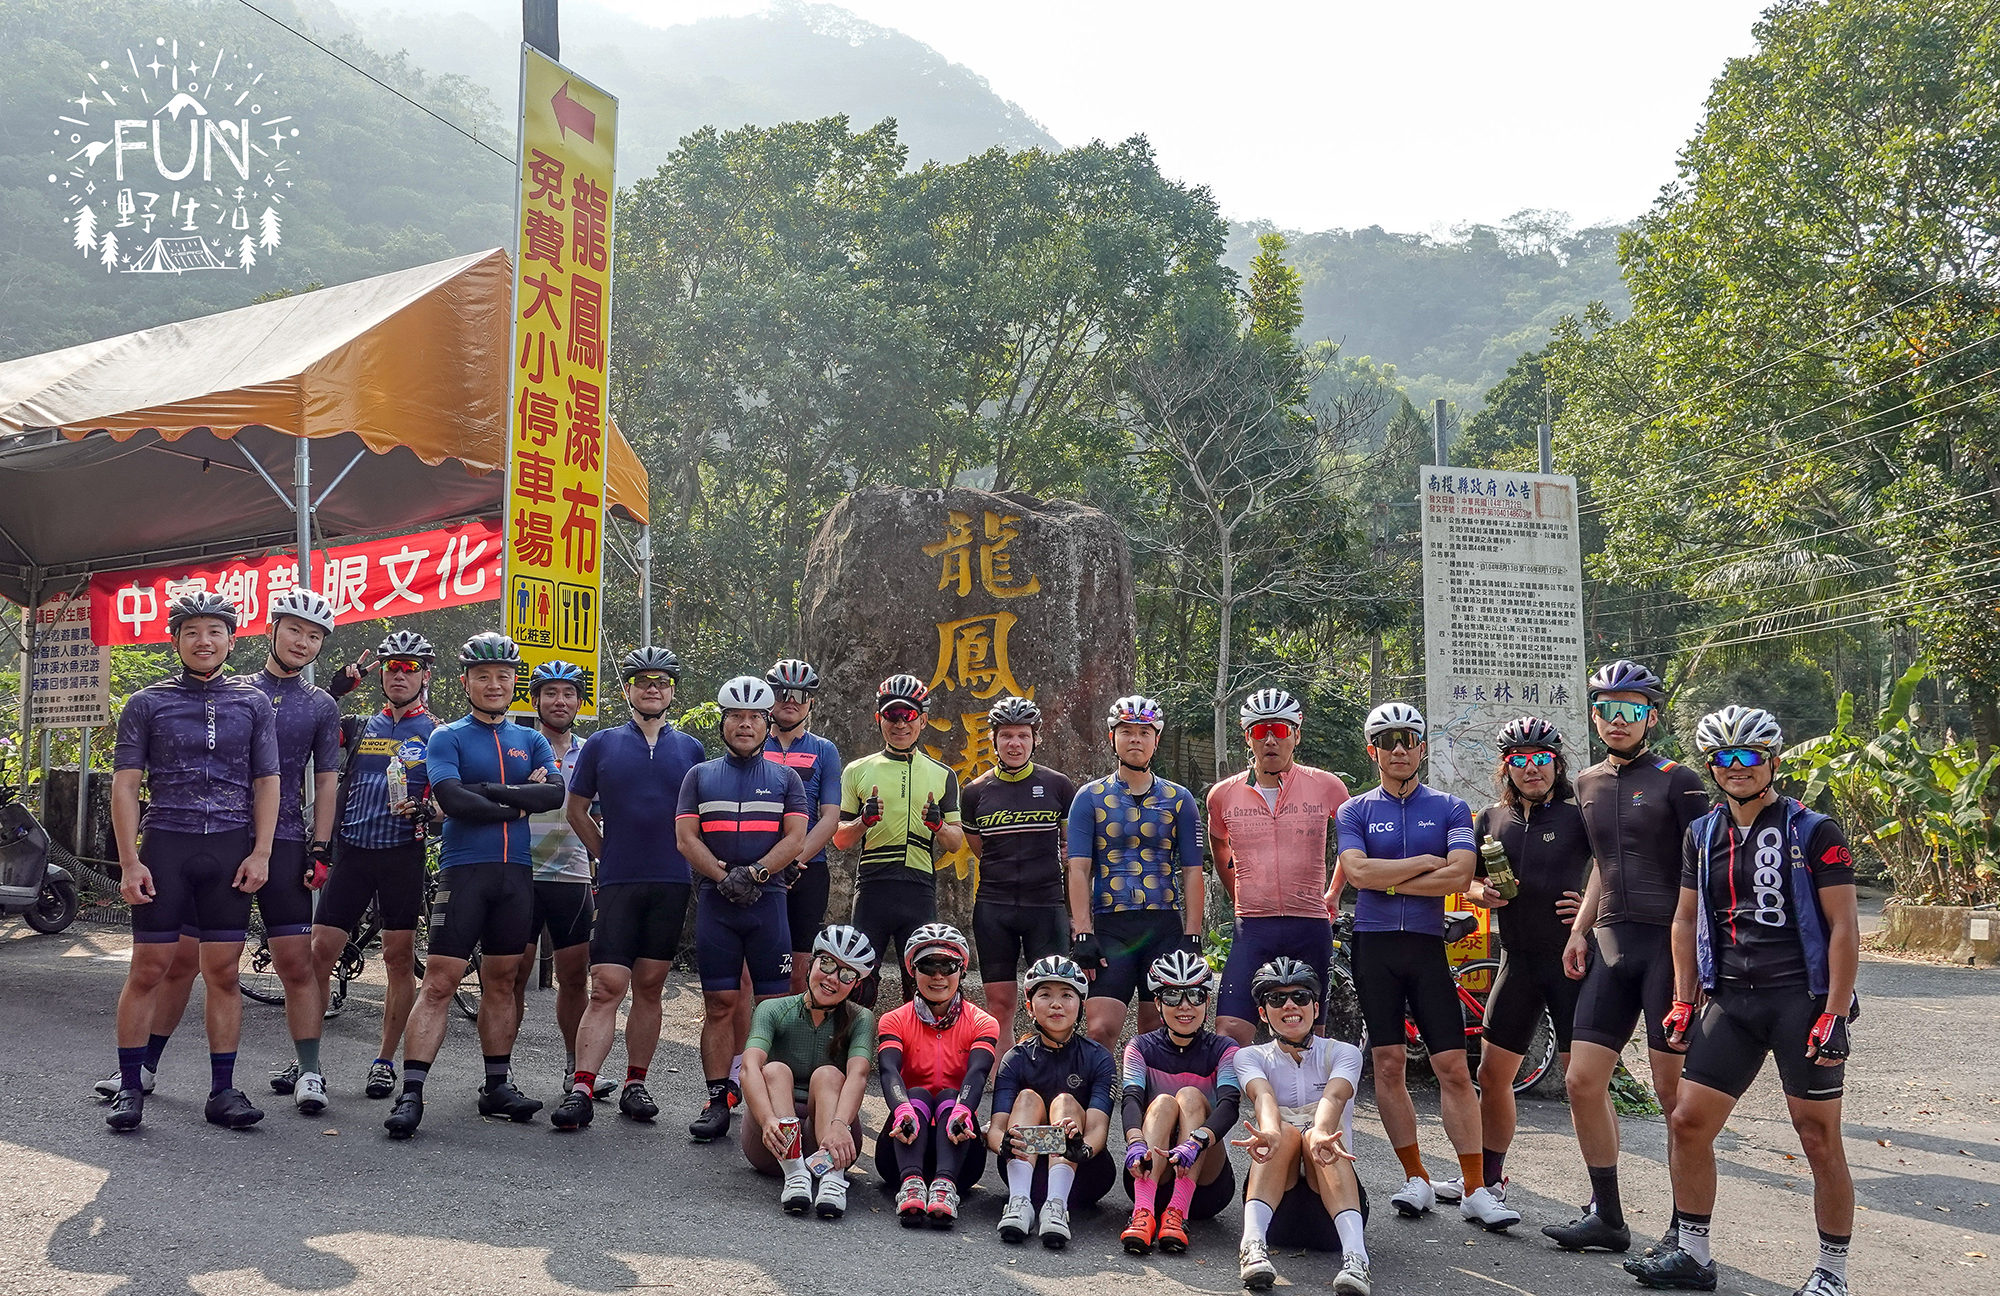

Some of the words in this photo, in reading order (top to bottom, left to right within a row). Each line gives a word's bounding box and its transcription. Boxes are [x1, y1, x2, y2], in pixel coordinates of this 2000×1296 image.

[514, 146, 566, 569] 免費大小停車場
[560, 171, 609, 575] 龍鳳瀑布
[1428, 474, 1497, 497] 南投縣政府
[1505, 480, 1531, 500] 公告
[117, 534, 502, 636] 中鄉眼文化
[515, 626, 551, 644] 化粧室
[922, 510, 1040, 903] 龍鳳瀑
[1453, 684, 1487, 701] 縣長
[207, 705, 216, 750] TEKTRO
[1302, 802, 1323, 815] Sport
[1369, 821, 1394, 834] RCC
